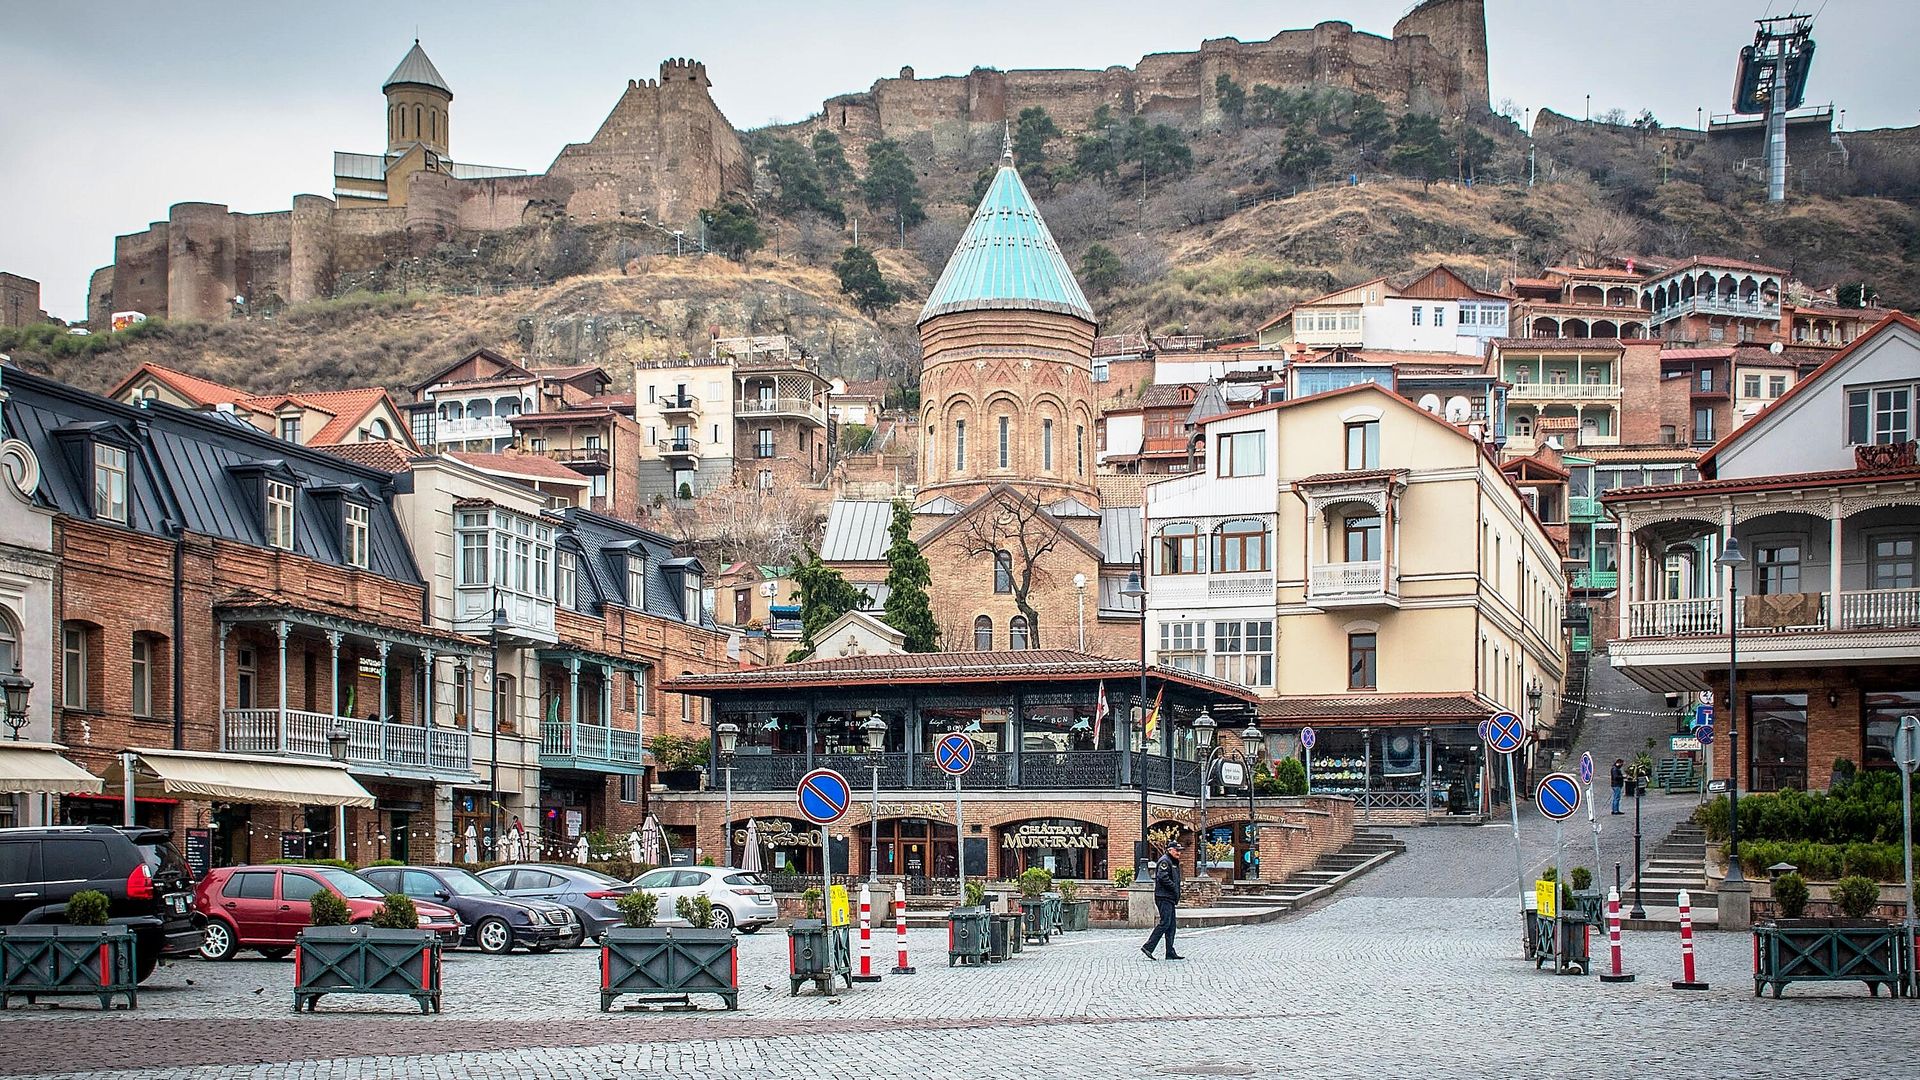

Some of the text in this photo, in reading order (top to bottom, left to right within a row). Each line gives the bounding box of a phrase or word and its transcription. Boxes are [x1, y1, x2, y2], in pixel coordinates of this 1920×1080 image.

[636, 358, 730, 370] HOTEL CITADEL NARIKALA
[1051, 716, 1068, 724] BCN
[910, 802, 948, 817] BAR
[1019, 822, 1083, 835] CHÂTEAU
[1001, 833, 1100, 849] MUKHRANI
